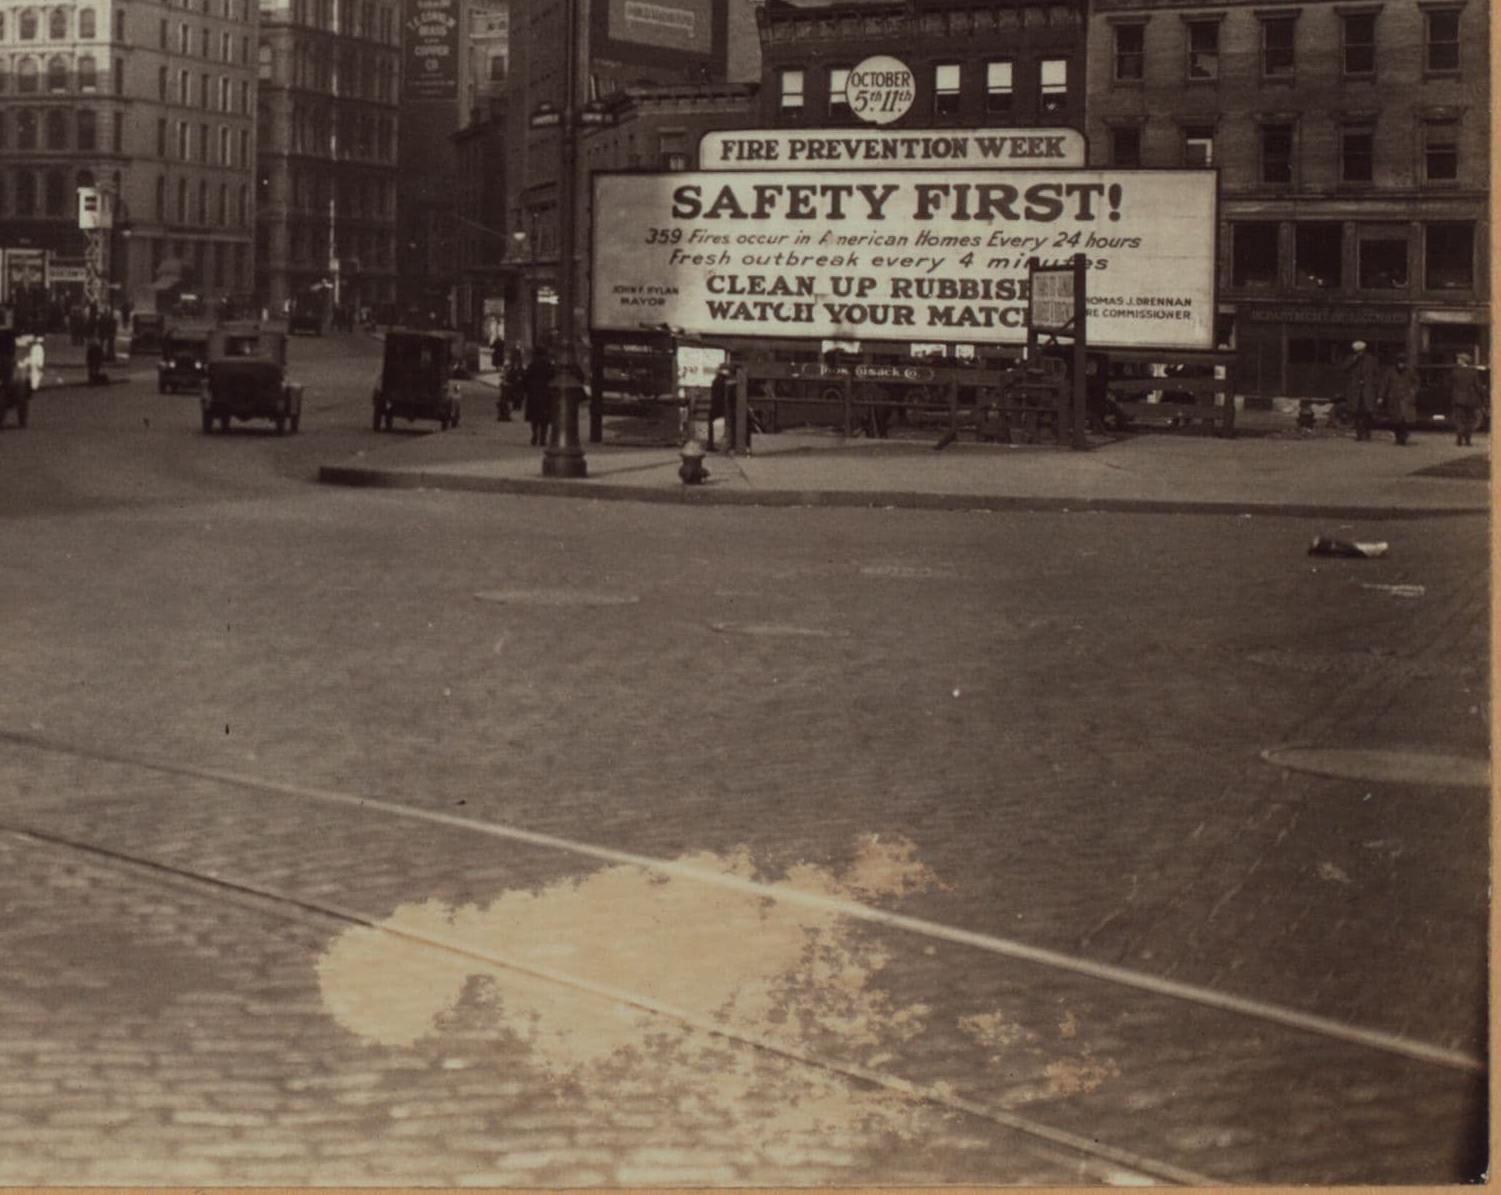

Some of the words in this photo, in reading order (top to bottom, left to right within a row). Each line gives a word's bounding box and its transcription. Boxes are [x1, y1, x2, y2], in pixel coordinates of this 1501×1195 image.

[851, 71, 911, 87] OCTOBER
[720, 139, 779, 160] FIRE
[788, 137, 968, 160] PREVENTION
[975, 136, 1066, 158] WEEK
[672, 184, 900, 221] SAFETY
[913, 183, 1123, 222] FIRST!
[645, 228, 683, 245] 359
[687, 229, 730, 245] Fires
[736, 232, 789, 245] occur
[794, 230, 811, 245] in
[915, 230, 981, 248] Homes
[986, 231, 1048, 252] Every
[1053, 231, 1080, 248] 24
[1085, 231, 1142, 249] hours
[669, 249, 731, 266] Fresh
[742, 249, 858, 267] outbreak
[871, 254, 945, 273] every
[959, 252, 974, 269] 4
[706, 275, 816, 297] CLEAN
[830, 276, 877, 298] UP
[620, 297, 666, 306] MAYOR
[1136, 297, 1192, 307] DRENNAN
[706, 301, 816, 323] WATCH
[823, 303, 916, 326] YOUR
[1102, 308, 1192, 320] COMMISSIONER
